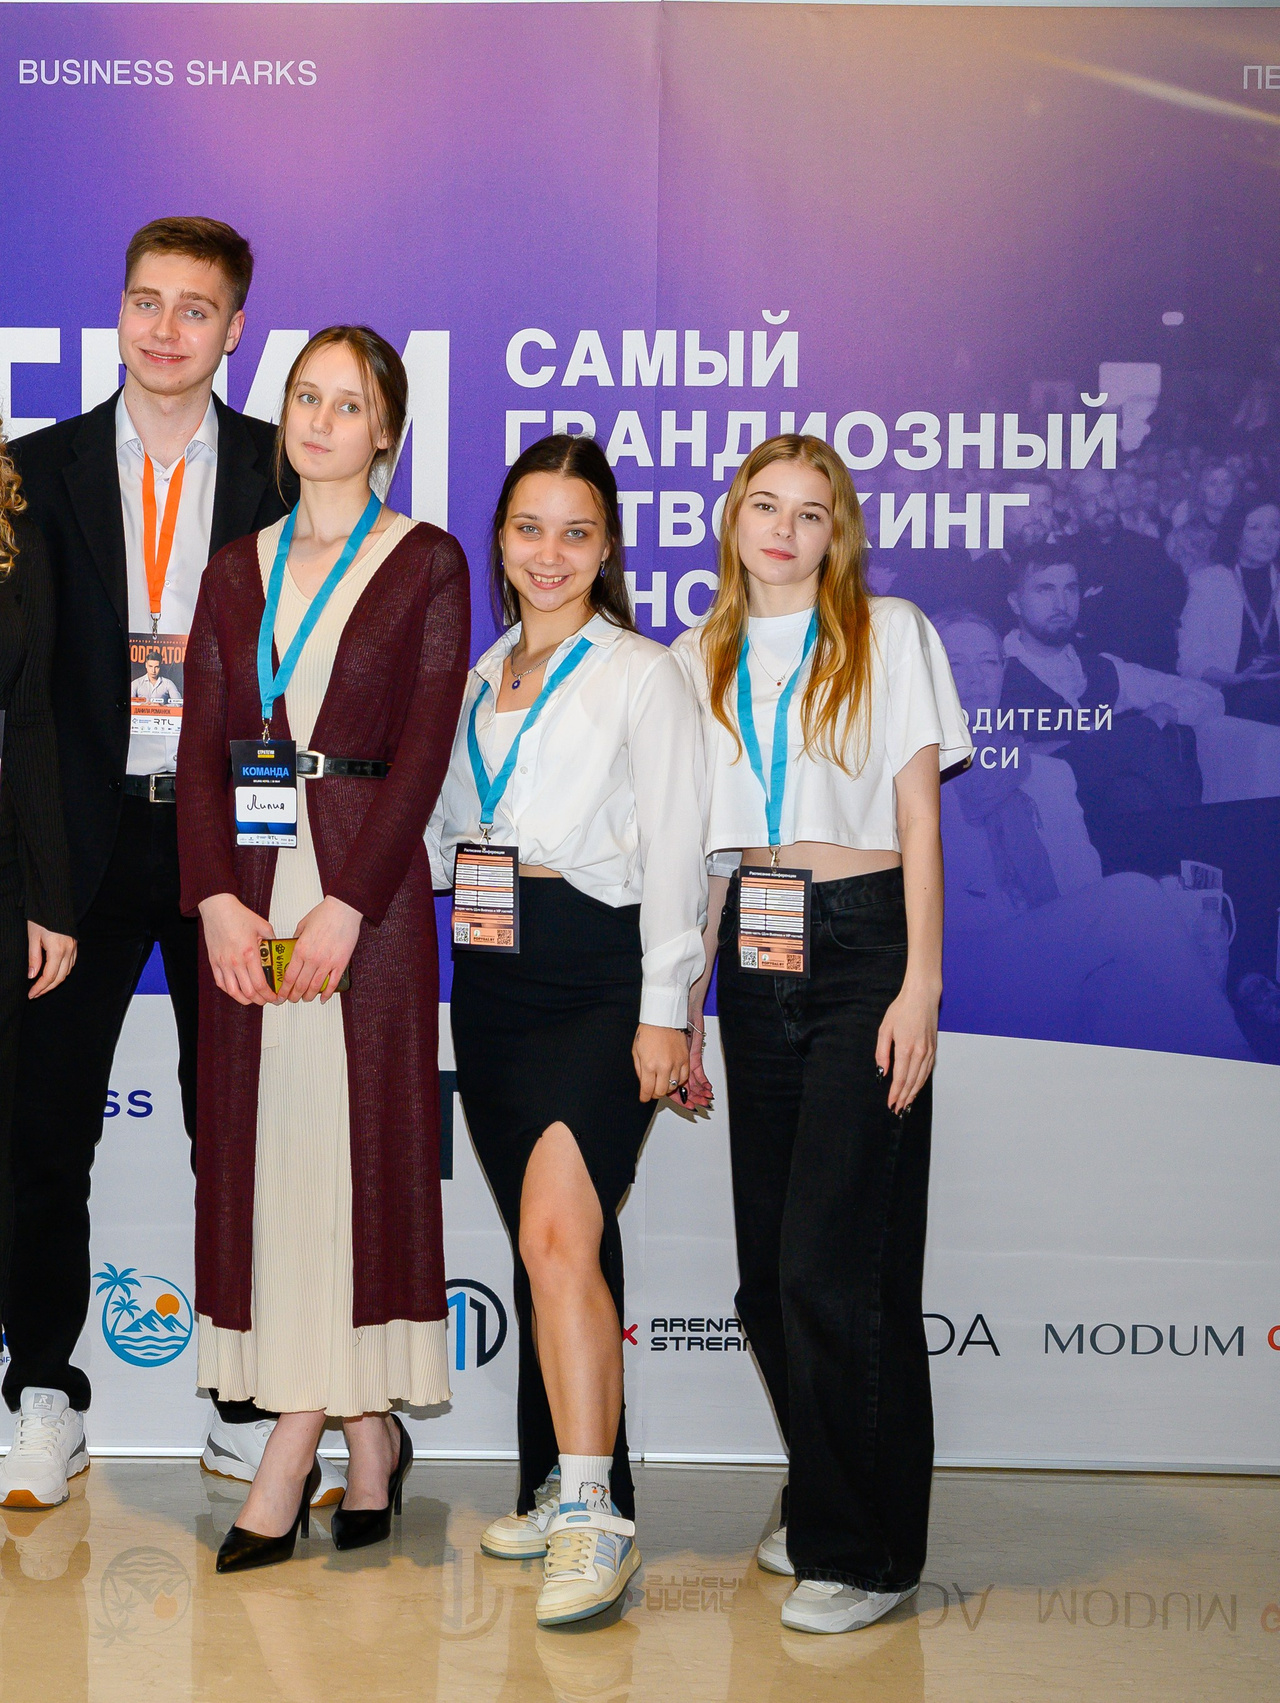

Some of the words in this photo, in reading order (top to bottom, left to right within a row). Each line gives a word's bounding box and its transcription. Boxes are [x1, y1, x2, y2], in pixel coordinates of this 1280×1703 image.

[19, 59, 175, 86] BUSINESS
[186, 60, 317, 86] SHARKS
[505, 309, 799, 388] САМЫЙ
[242, 766, 289, 778] КОМАНДА
[650, 1318, 742, 1333] ARENA
[1045, 1323, 1244, 1357] MODUM
